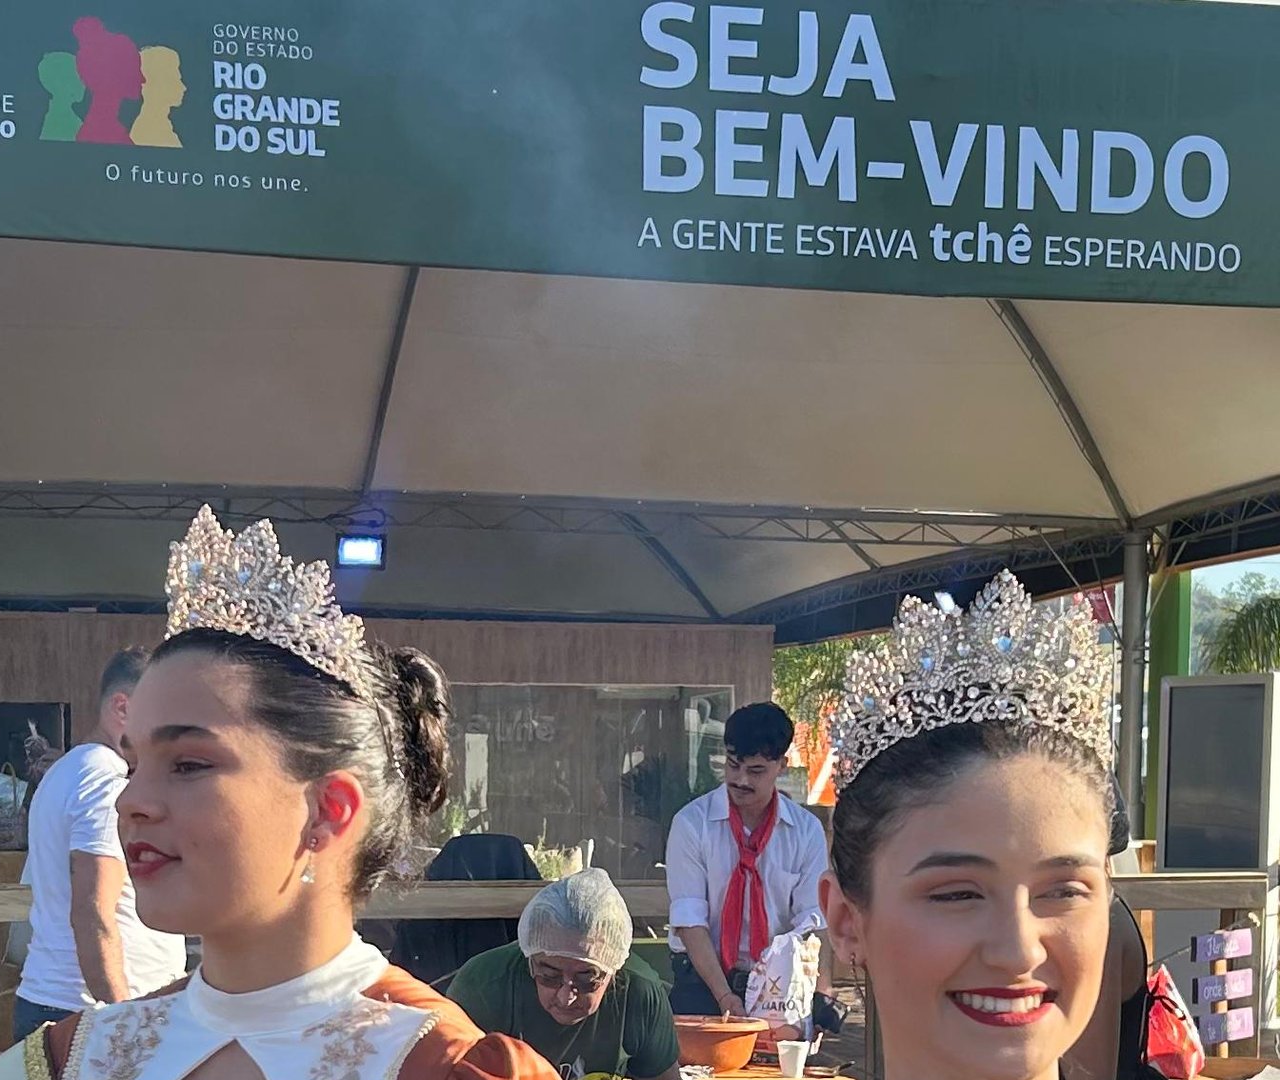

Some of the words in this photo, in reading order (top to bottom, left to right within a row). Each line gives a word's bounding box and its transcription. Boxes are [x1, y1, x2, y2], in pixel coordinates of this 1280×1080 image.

[213, 23, 300, 42] GOVERNO
[213, 40, 239, 56] DO
[245, 42, 314, 60] ESTADO
[639, 1, 897, 101] SEJA
[213, 61, 266, 90] RIO
[213, 93, 341, 127] GRANDE
[214, 124, 261, 153] DO
[266, 127, 326, 158] SUL
[105, 163, 121, 182] O
[130, 164, 204, 187] futuro
[213, 173, 252, 190] nos
[261, 177, 309, 193] une.
[641, 104, 1231, 219] BEM-VINDO
[637, 216, 662, 248] A
[672, 218, 784, 255] GENTE
[795, 224, 918, 260] ESTAVA
[929, 221, 1032, 265] tchê
[1045, 235, 1242, 274] ESPERANDO
